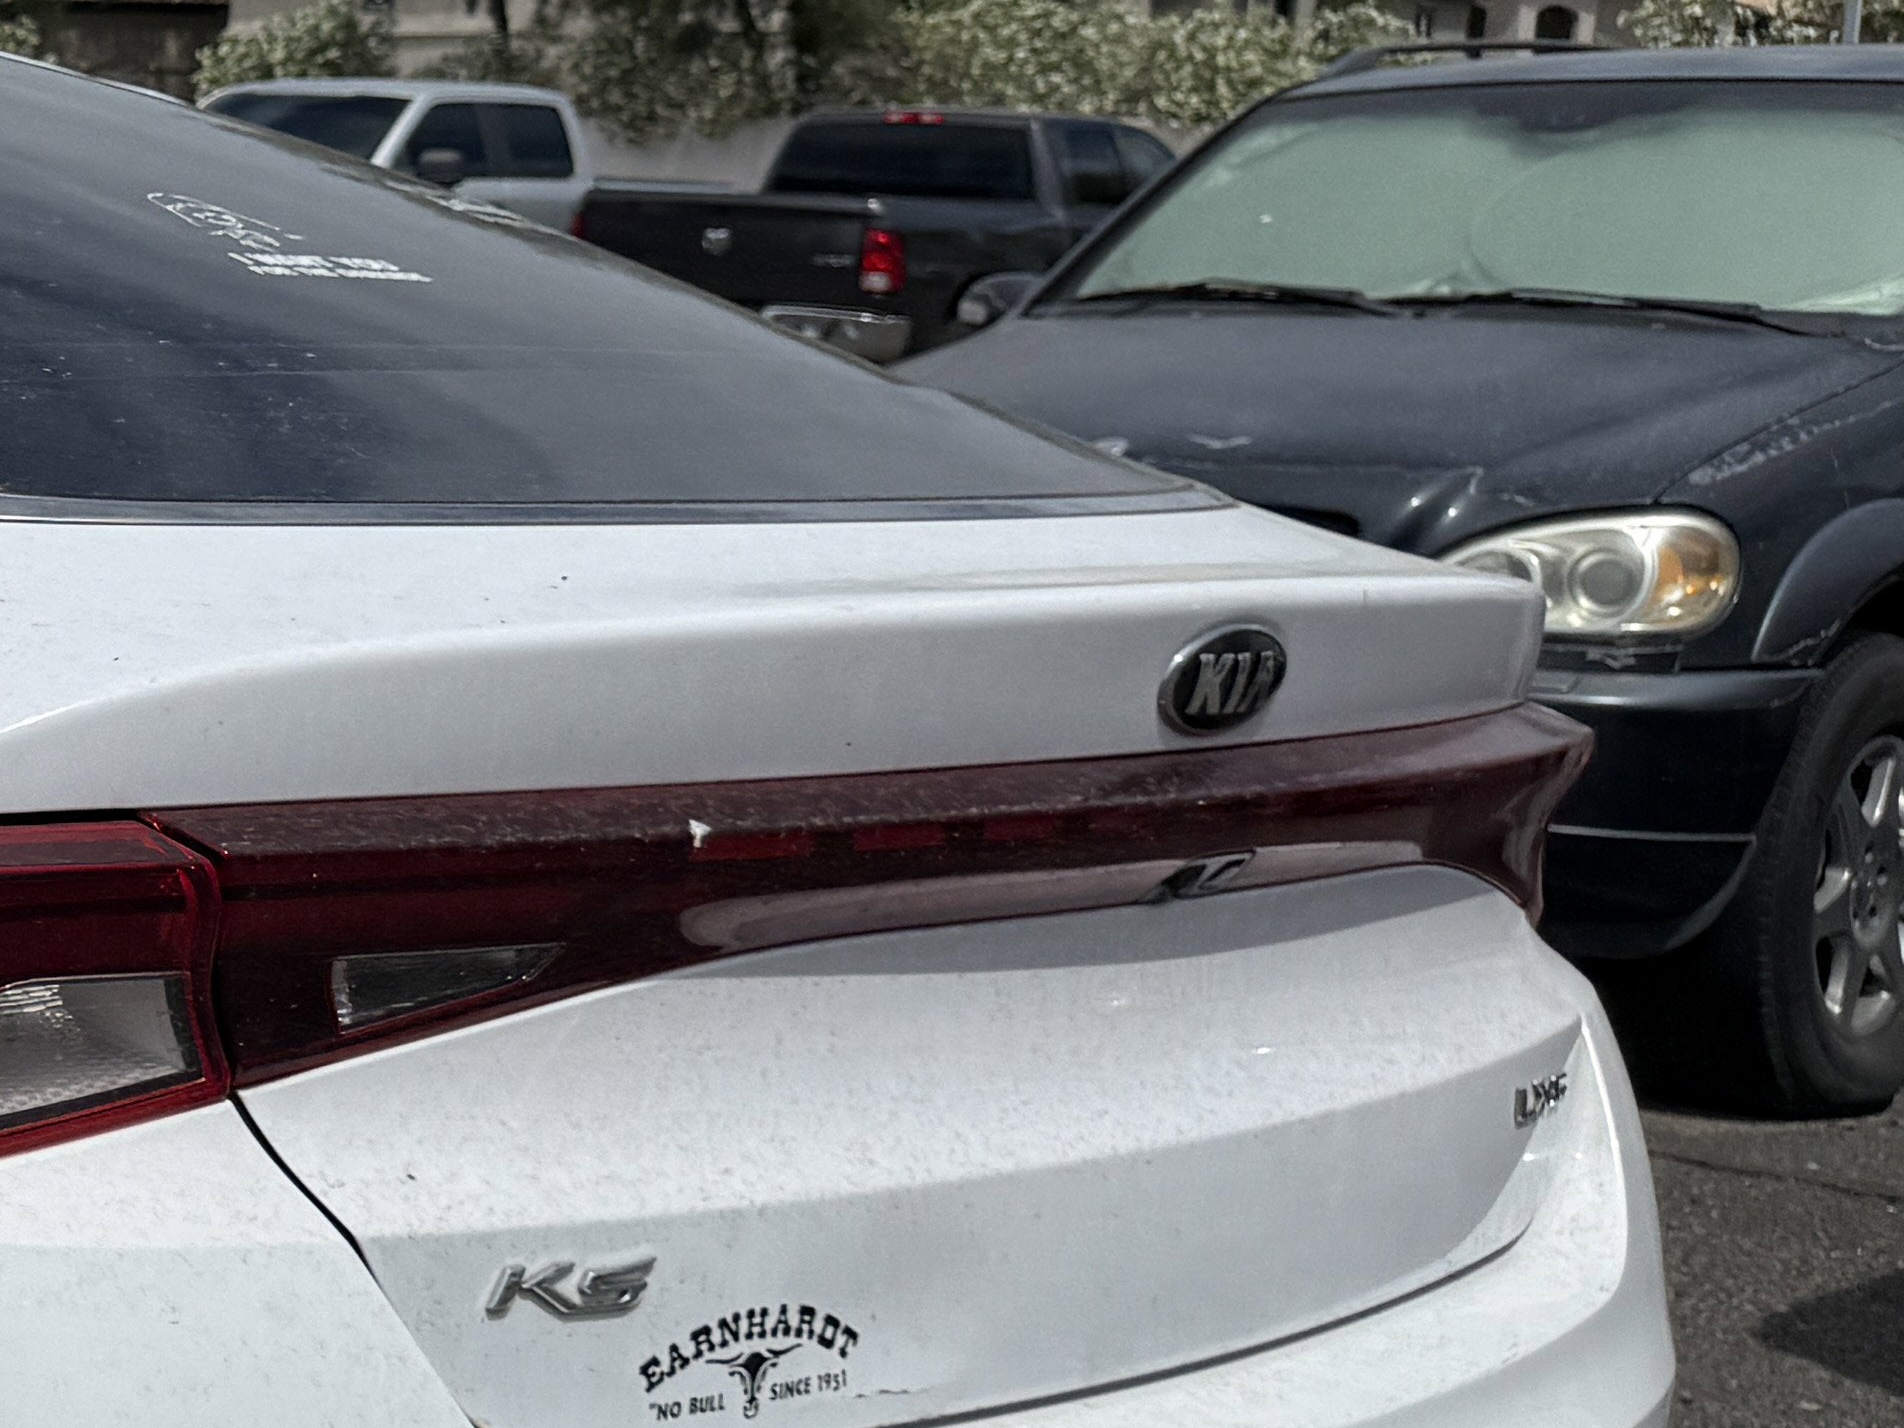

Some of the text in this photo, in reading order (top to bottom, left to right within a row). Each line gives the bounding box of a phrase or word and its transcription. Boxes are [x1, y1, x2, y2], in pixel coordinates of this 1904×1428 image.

[1185, 649, 1279, 716] KIA
[484, 1256, 657, 1324] K5
[638, 1303, 860, 1394] EARNHARDT
[769, 1376, 812, 1401] SINCE
[817, 1368, 848, 1392] 1951
